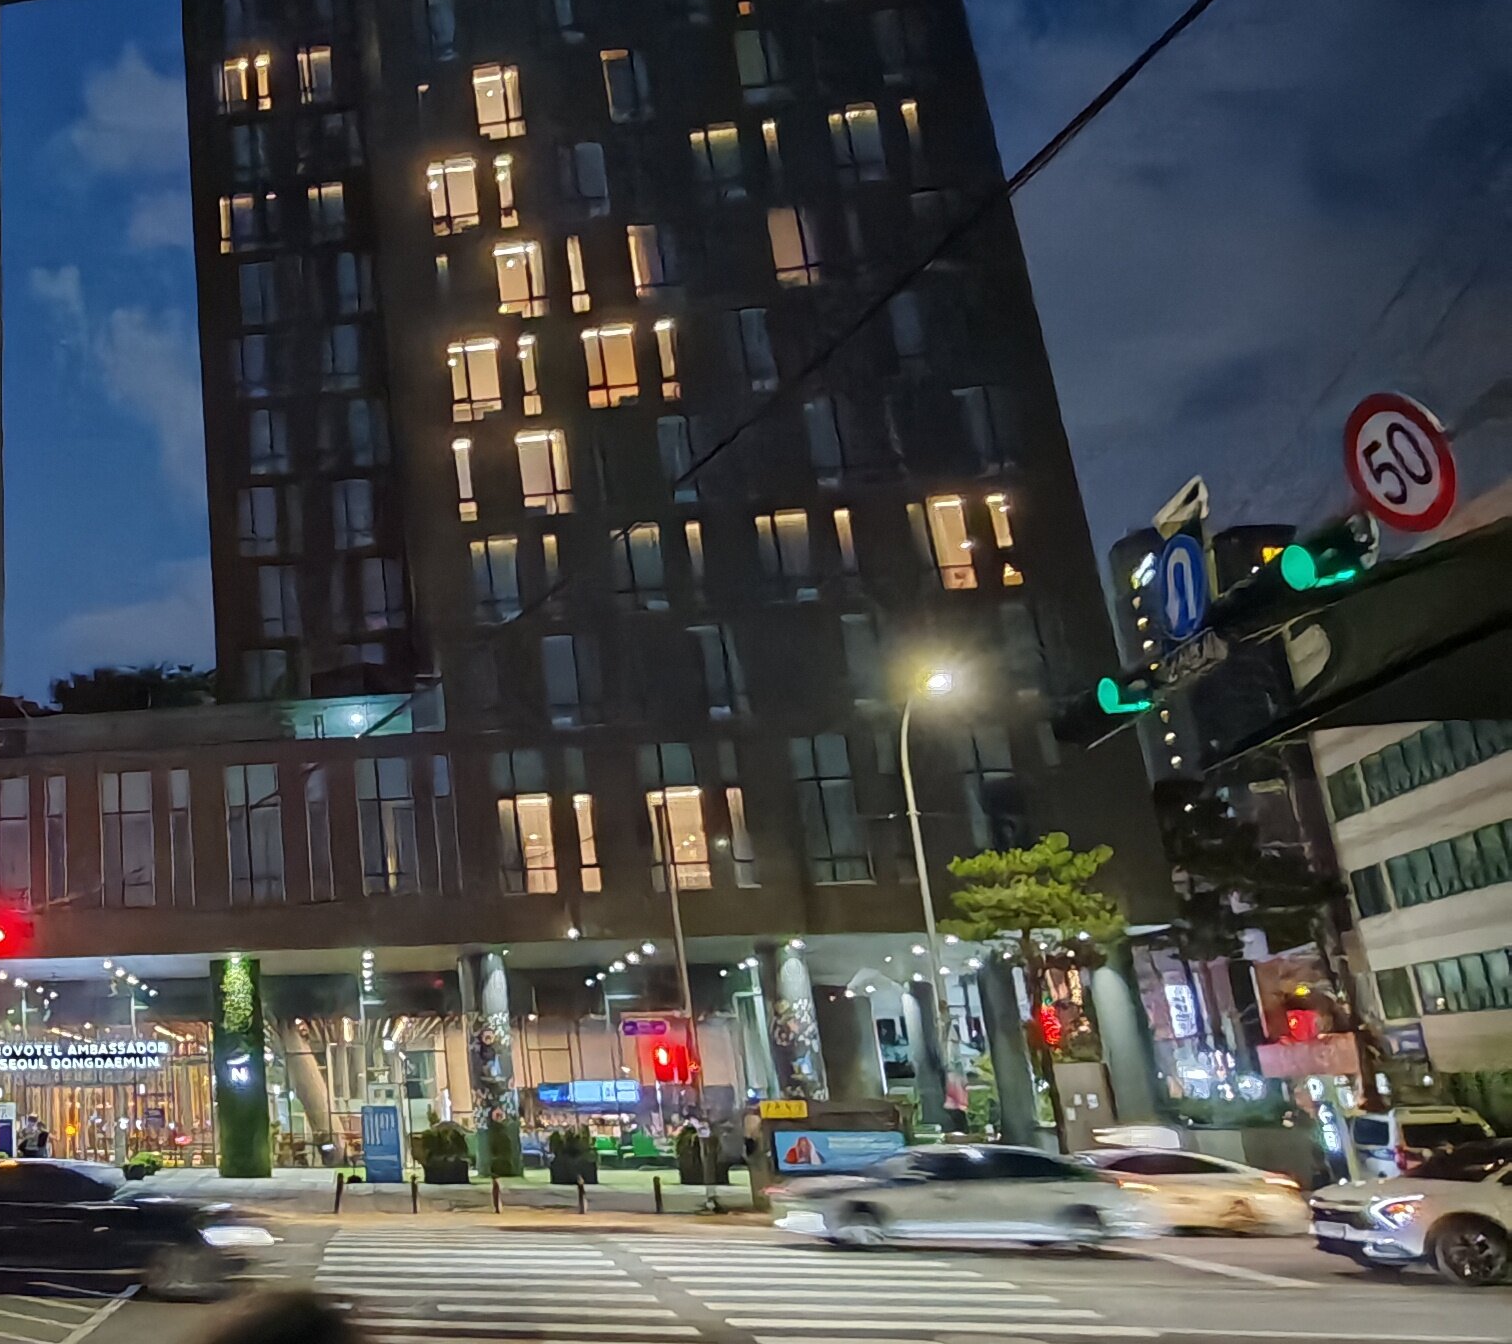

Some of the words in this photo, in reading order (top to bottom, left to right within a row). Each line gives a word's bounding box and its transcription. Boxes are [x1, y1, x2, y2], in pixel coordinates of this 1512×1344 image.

[1361, 422, 1433, 505] 50
[67, 1041, 169, 1055] AMBASSADOR
[50, 1056, 161, 1069] DONGDAEMUN
[232, 1067, 249, 1082] N
